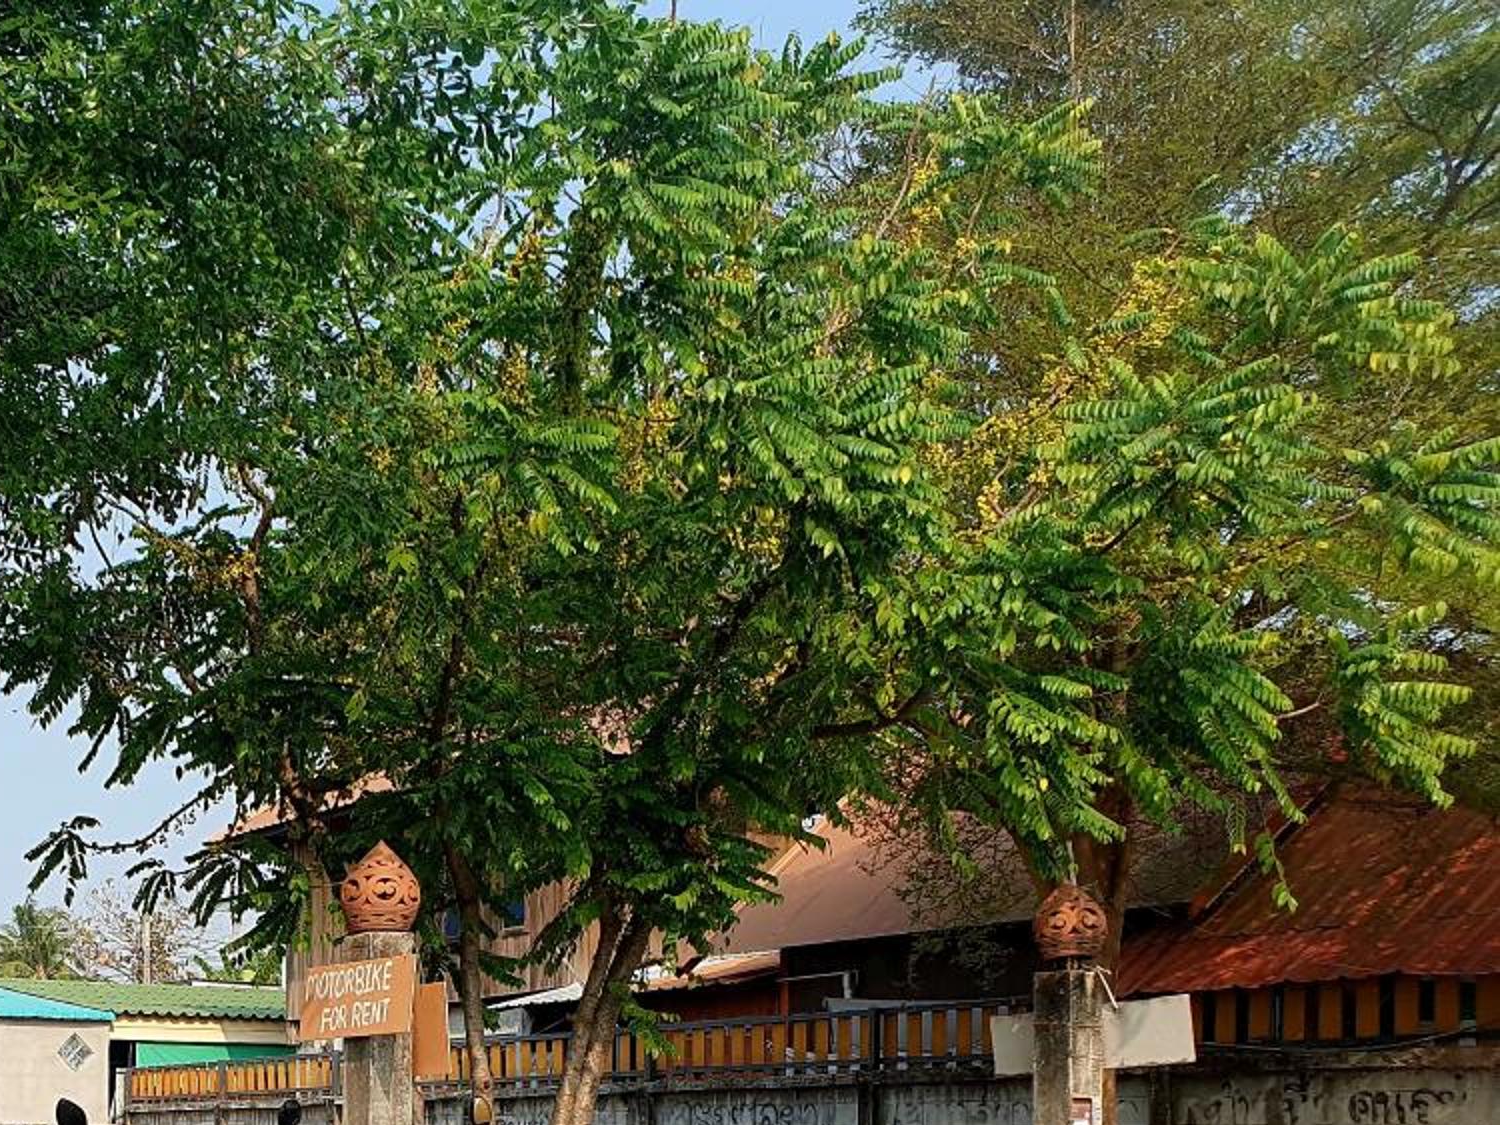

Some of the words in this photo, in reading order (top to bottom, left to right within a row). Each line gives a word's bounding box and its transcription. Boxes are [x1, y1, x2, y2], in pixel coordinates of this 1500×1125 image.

[305, 961, 393, 1001] MOTORBIKE
[320, 1005, 347, 1032] FOR
[351, 998, 390, 1028] RENT
